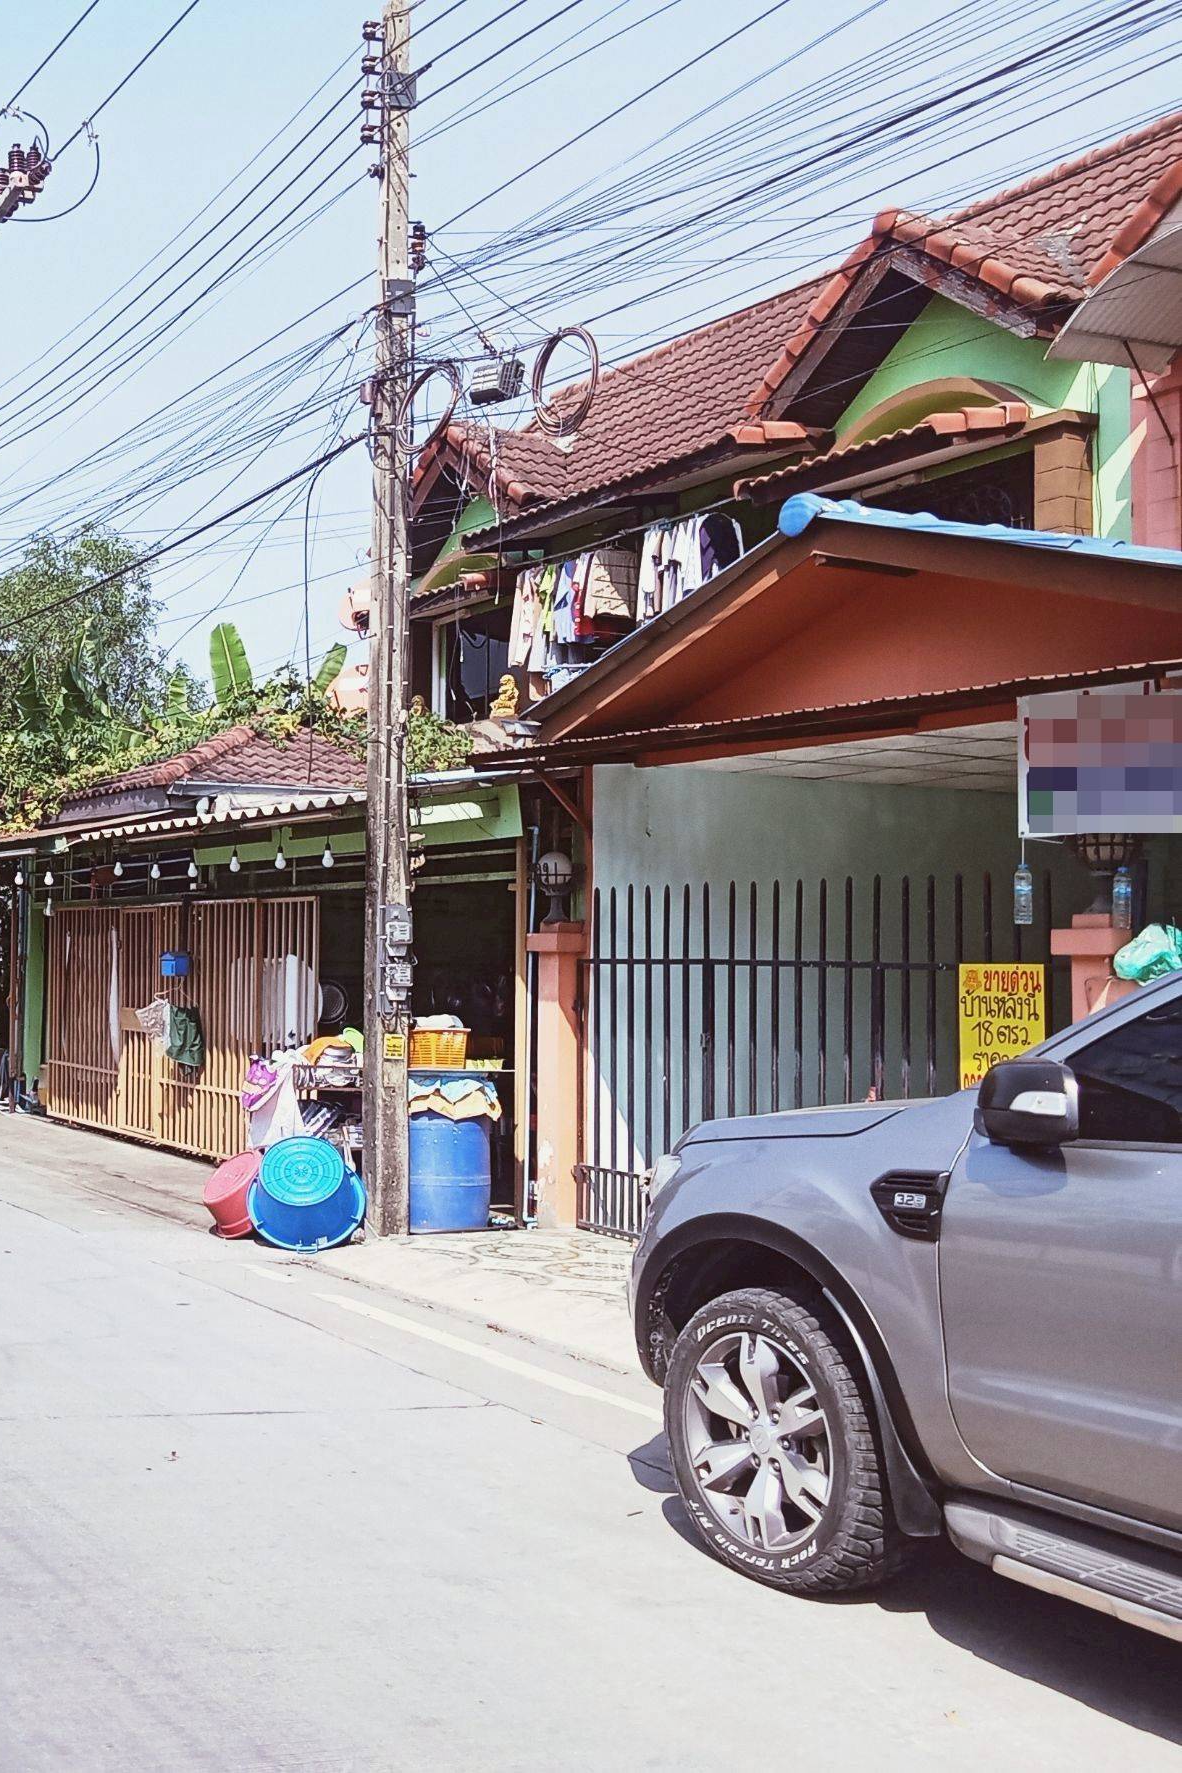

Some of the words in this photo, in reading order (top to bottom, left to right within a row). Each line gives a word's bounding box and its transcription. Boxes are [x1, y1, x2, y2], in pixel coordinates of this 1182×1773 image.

[983, 966, 1042, 993] ขายด่วน
[971, 1020, 994, 1047] 18
